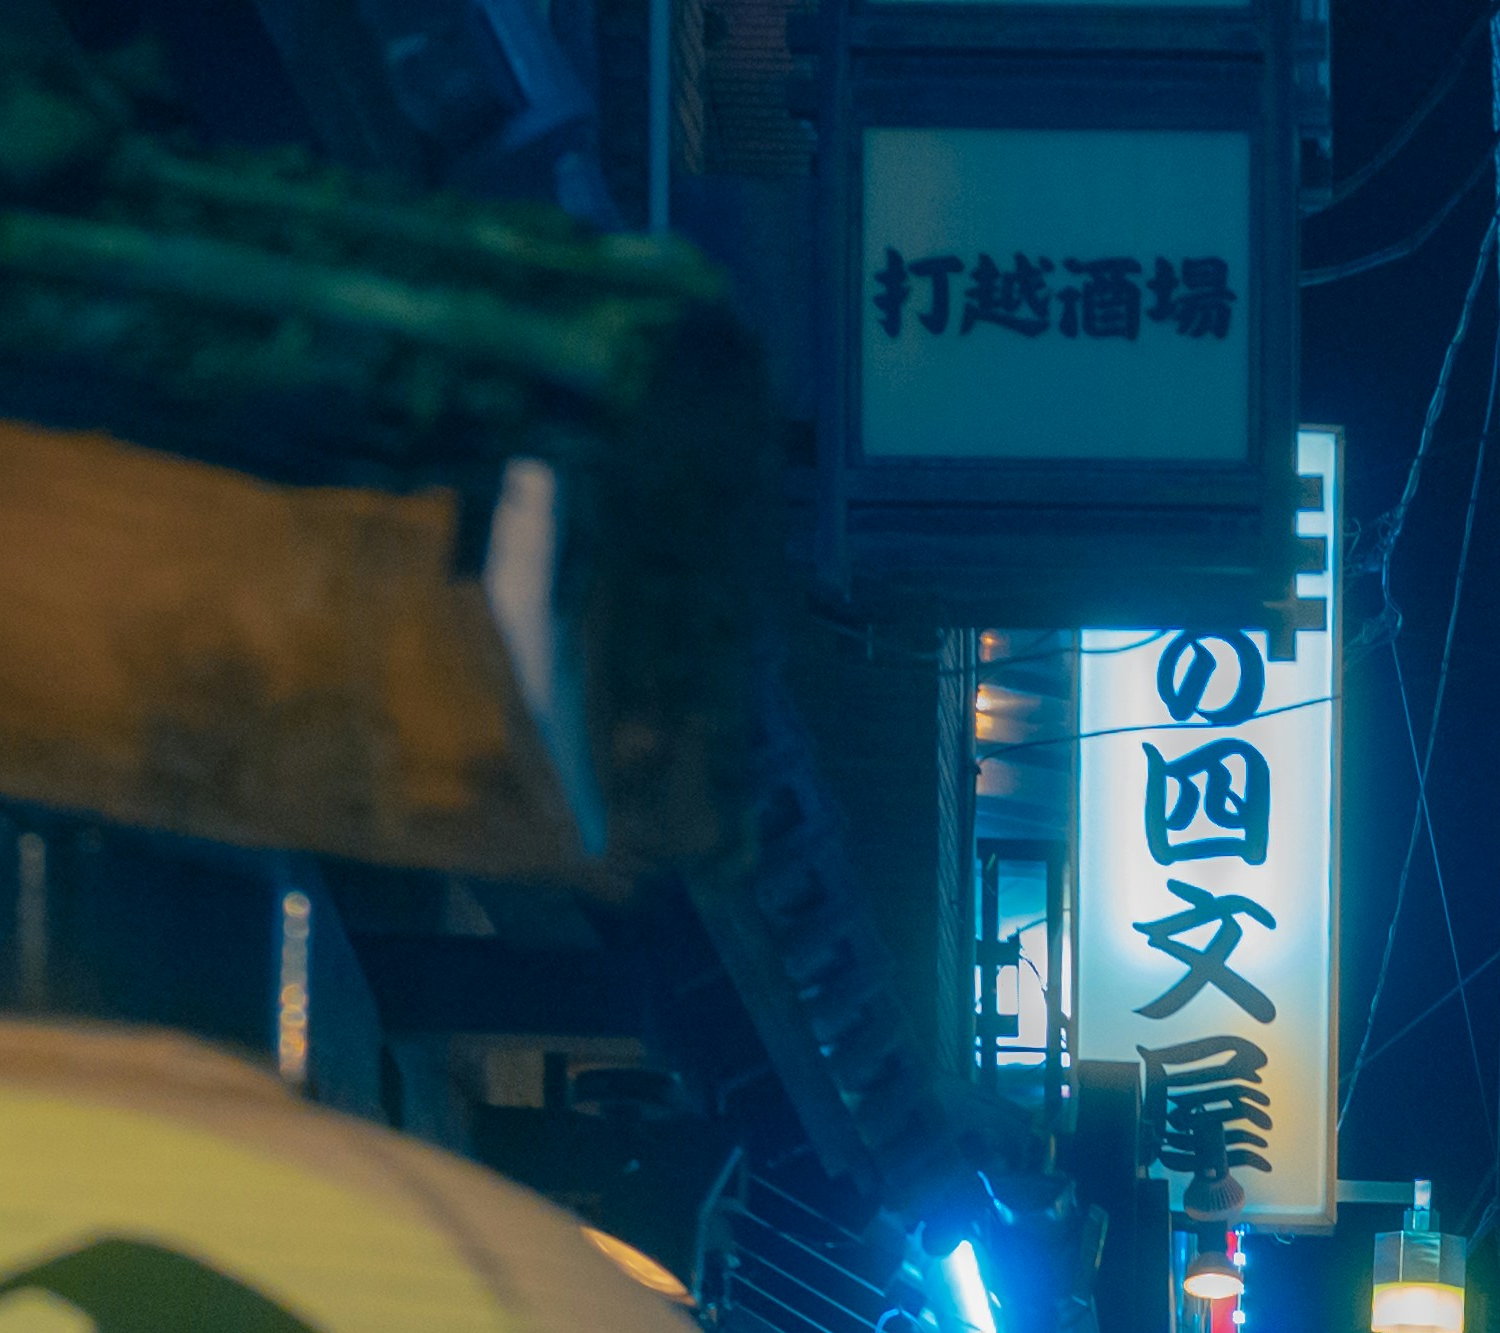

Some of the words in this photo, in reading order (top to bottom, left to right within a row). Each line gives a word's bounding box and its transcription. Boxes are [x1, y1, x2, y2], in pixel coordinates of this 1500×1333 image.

[874, 246, 1238, 342] 打越酒場
[1132, 628, 1277, 1175] の四文屋
